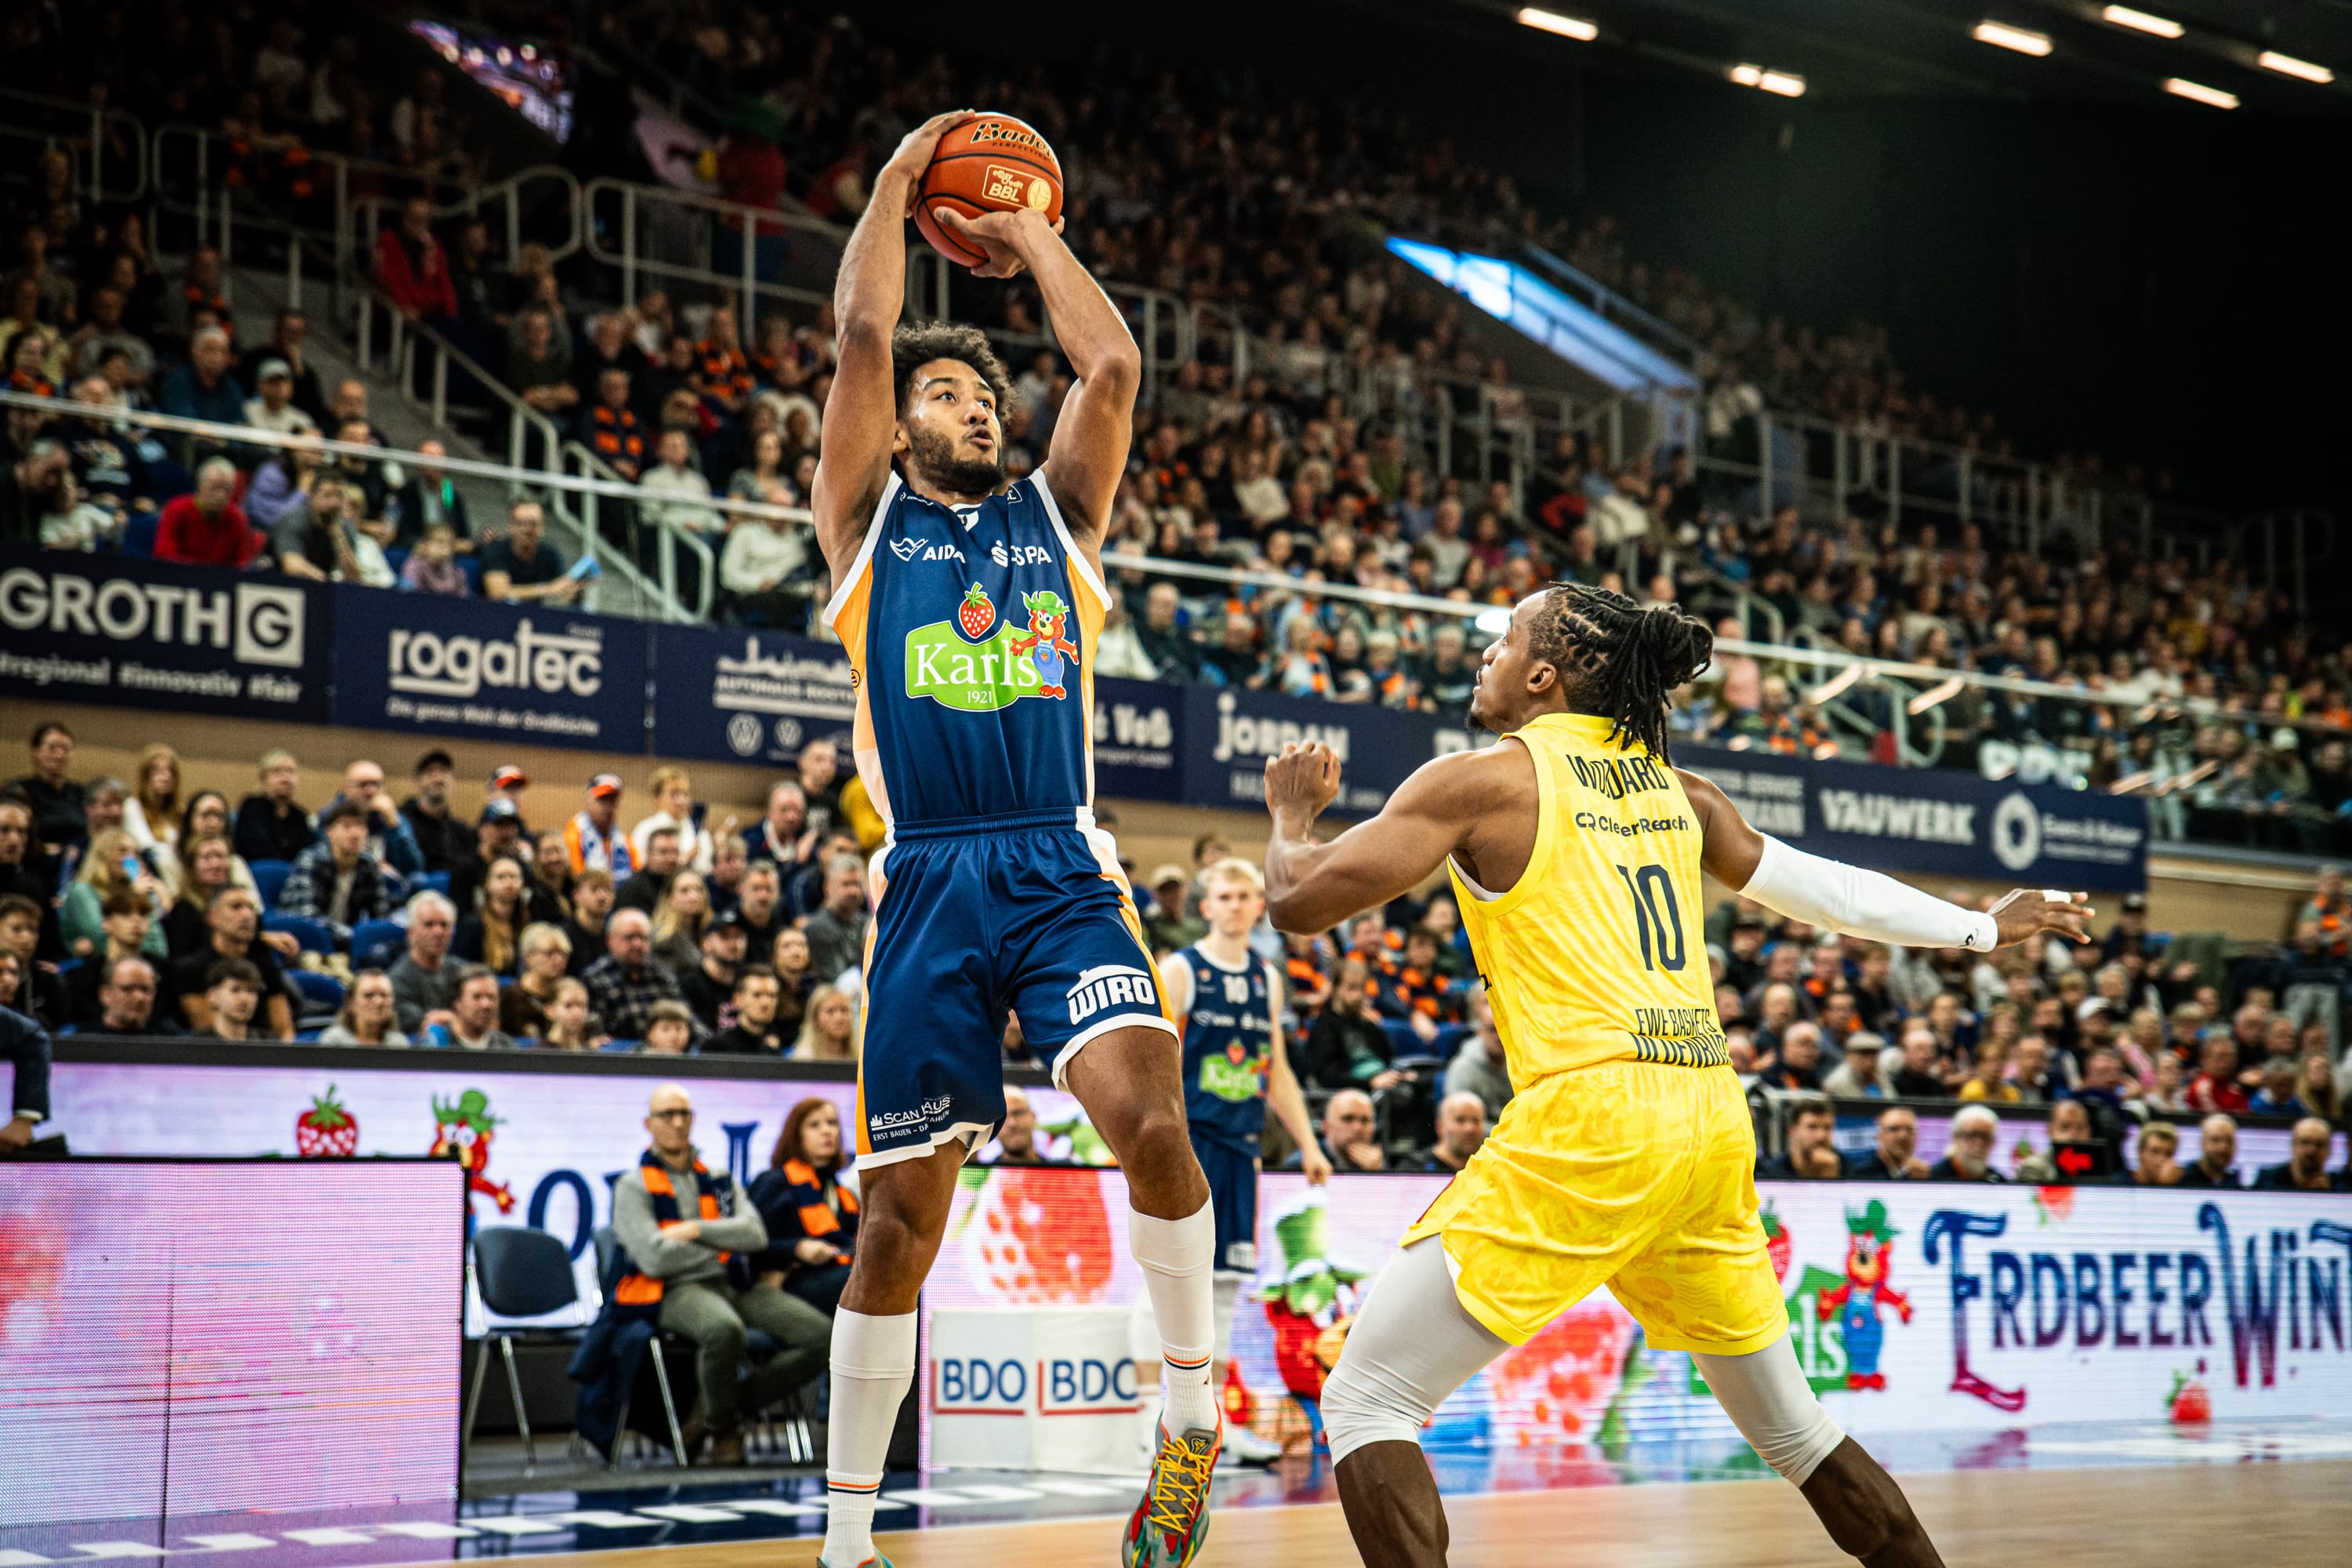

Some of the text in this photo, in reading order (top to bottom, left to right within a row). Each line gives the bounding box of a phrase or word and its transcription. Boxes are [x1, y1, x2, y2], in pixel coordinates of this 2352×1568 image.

[988, 183, 1020, 202] BBL
[0, 568, 230, 649] GROTH
[388, 619, 602, 697] rogatec
[913, 640, 1038, 688] Karls
[117, 661, 241, 697] #innovativ
[247, 673, 302, 702] #fair
[967, 691, 993, 703] 1921
[1599, 815, 1689, 837] CleerReach
[1819, 789, 1976, 845] VAUWERK
[1617, 864, 1686, 971] 10
[1068, 975, 1156, 1025] WIRO
[1635, 1007, 1717, 1036] EWE BASKETS
[873, 1133, 888, 1142] ERST
[942, 1359, 1028, 1403] BDO
